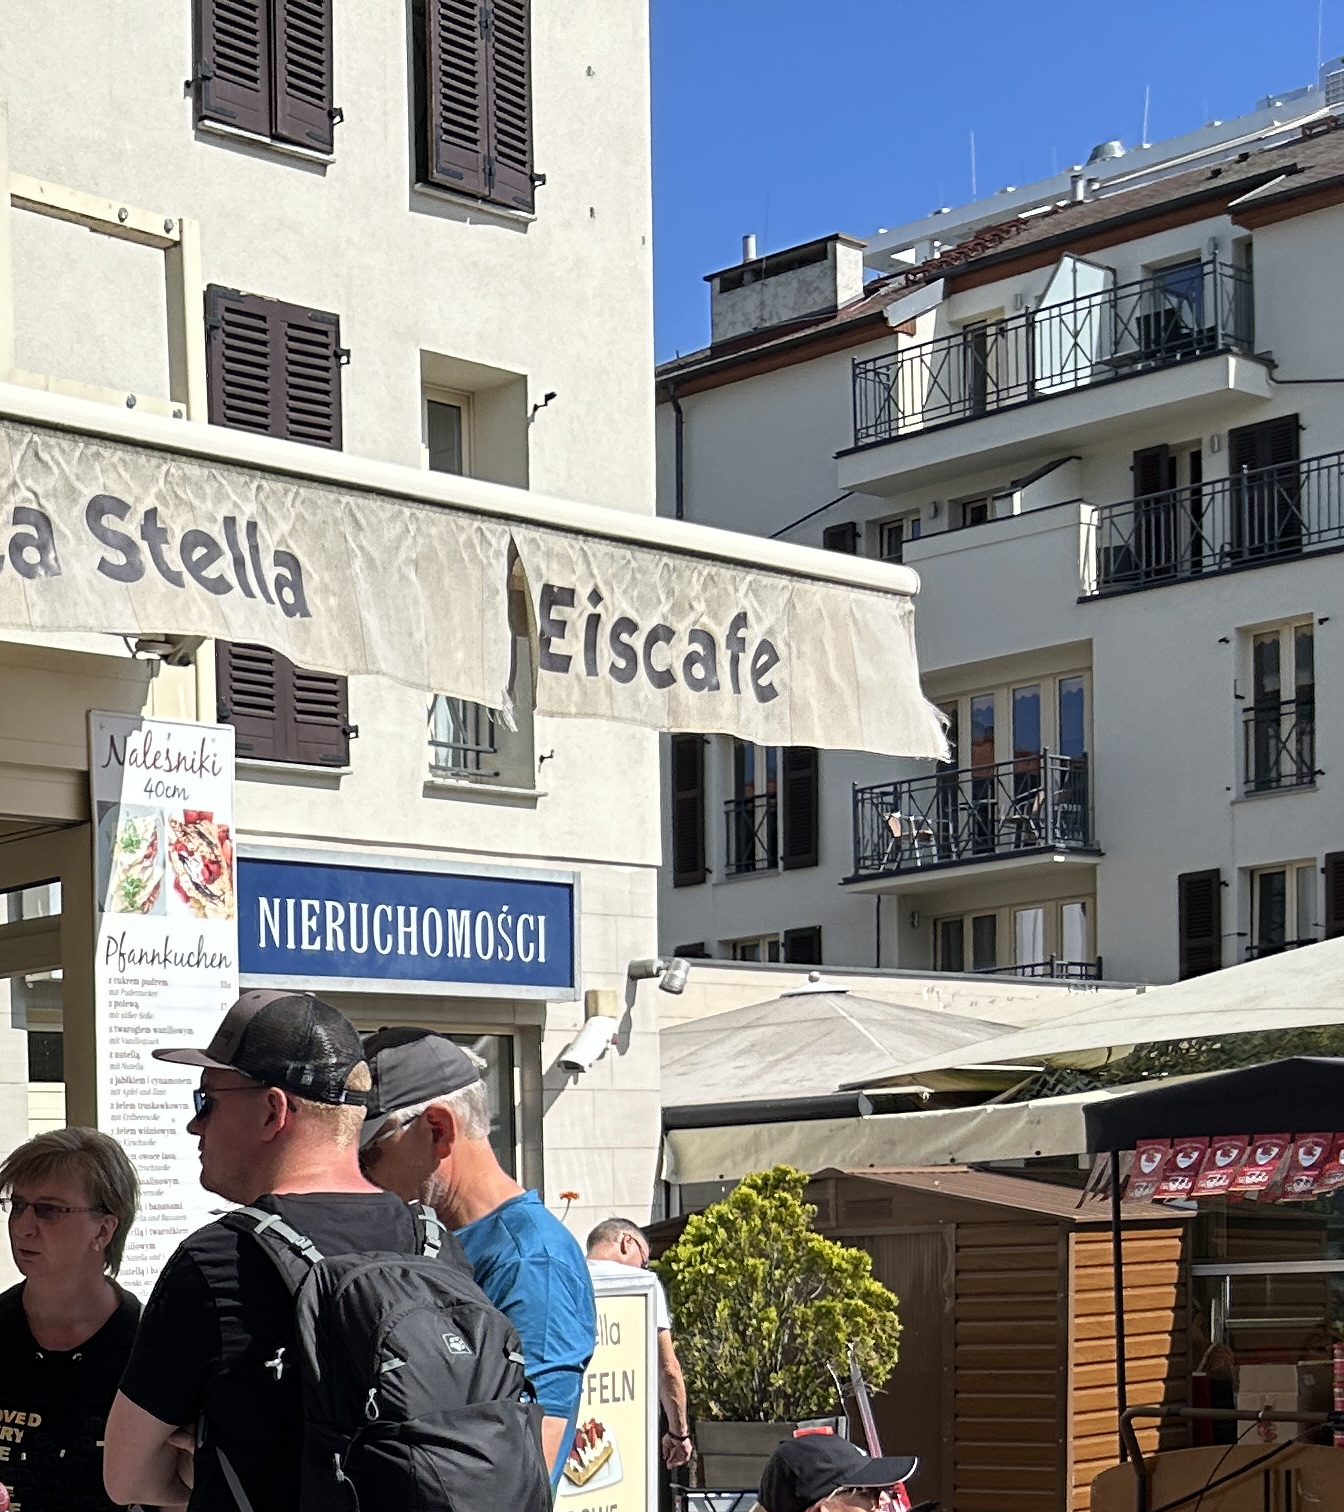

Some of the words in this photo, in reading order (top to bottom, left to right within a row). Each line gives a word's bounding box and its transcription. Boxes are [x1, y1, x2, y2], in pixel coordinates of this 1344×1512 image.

[84, 491, 313, 622] Stella
[101, 730, 222, 779] Naleśniki
[144, 777, 190, 800] 40cm
[105, 931, 232, 973] Pfannkuchen
[258, 897, 547, 963] NIERUCHOMOŚCI
